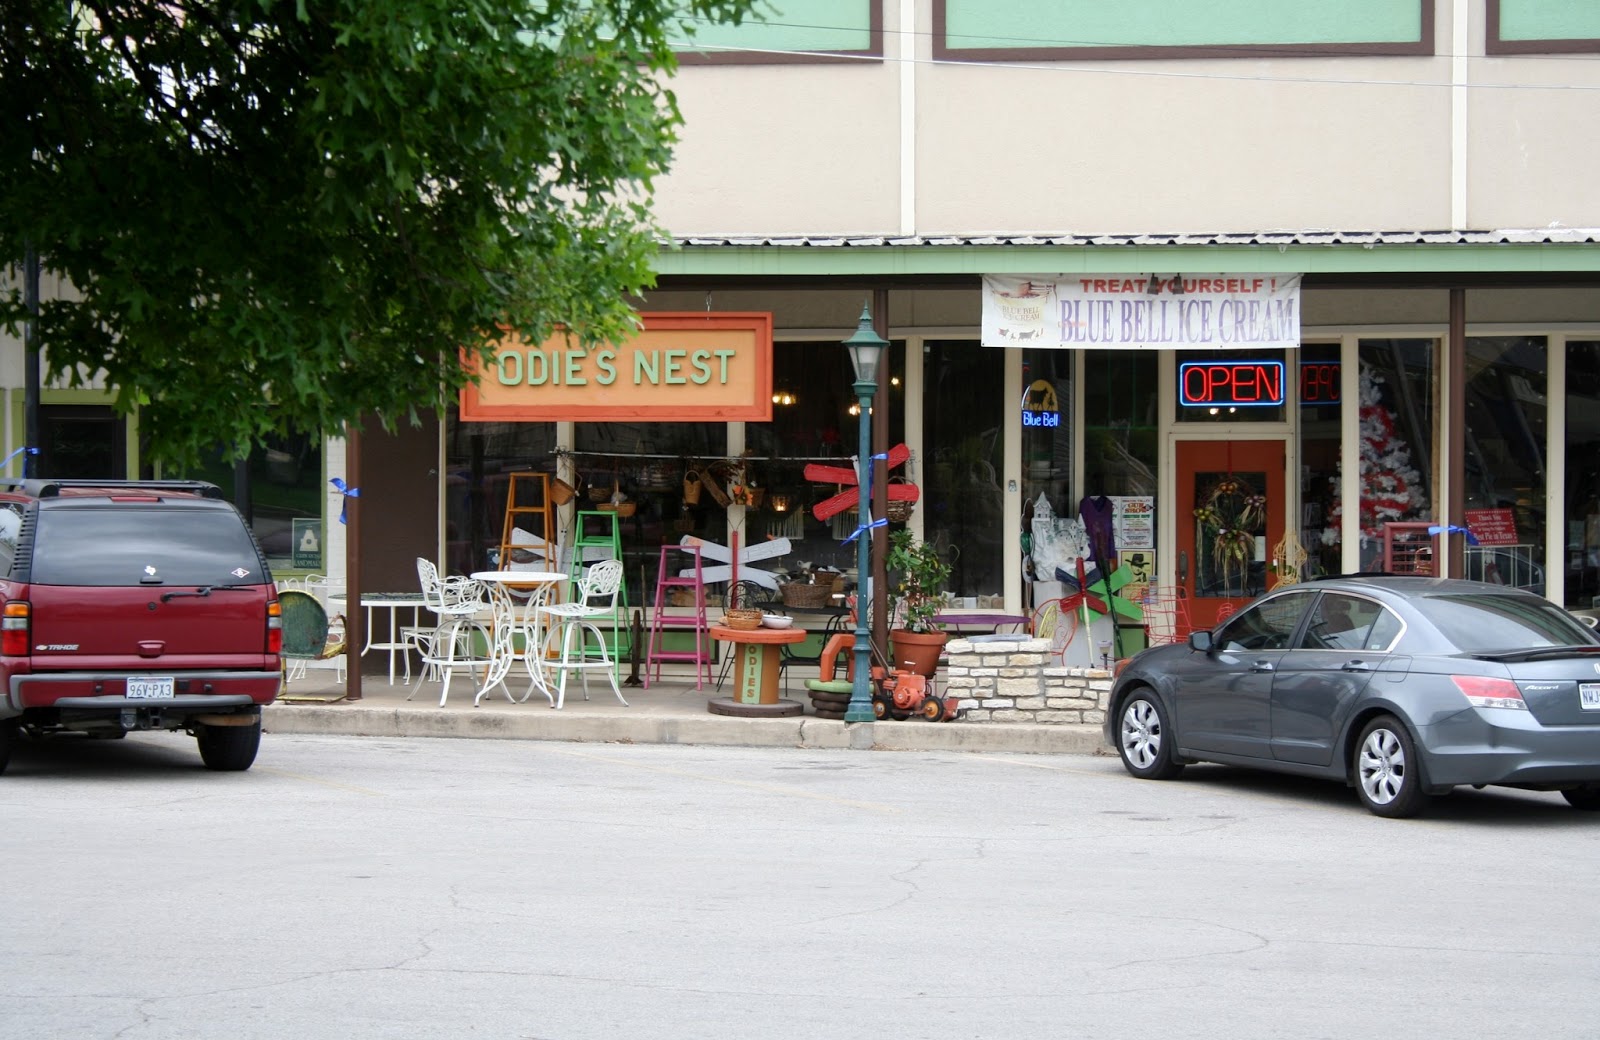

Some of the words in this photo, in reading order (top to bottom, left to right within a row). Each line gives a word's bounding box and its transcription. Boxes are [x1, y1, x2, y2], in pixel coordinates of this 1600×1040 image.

[1080, 279, 1147, 293] TREAT
[1002, 305, 1022, 315] BLUE
[1060, 300, 1114, 342] BLUE
[1120, 300, 1172, 342] BELL
[1178, 299, 1212, 342] ICE
[1219, 299, 1294, 342] CREAM
[634, 350, 736, 385] NEST
[1184, 365, 1279, 401] OPEN
[1022, 411, 1042, 426] Blue
[1042, 412, 1059, 427] Bell
[746, 645, 758, 698] ODIES
